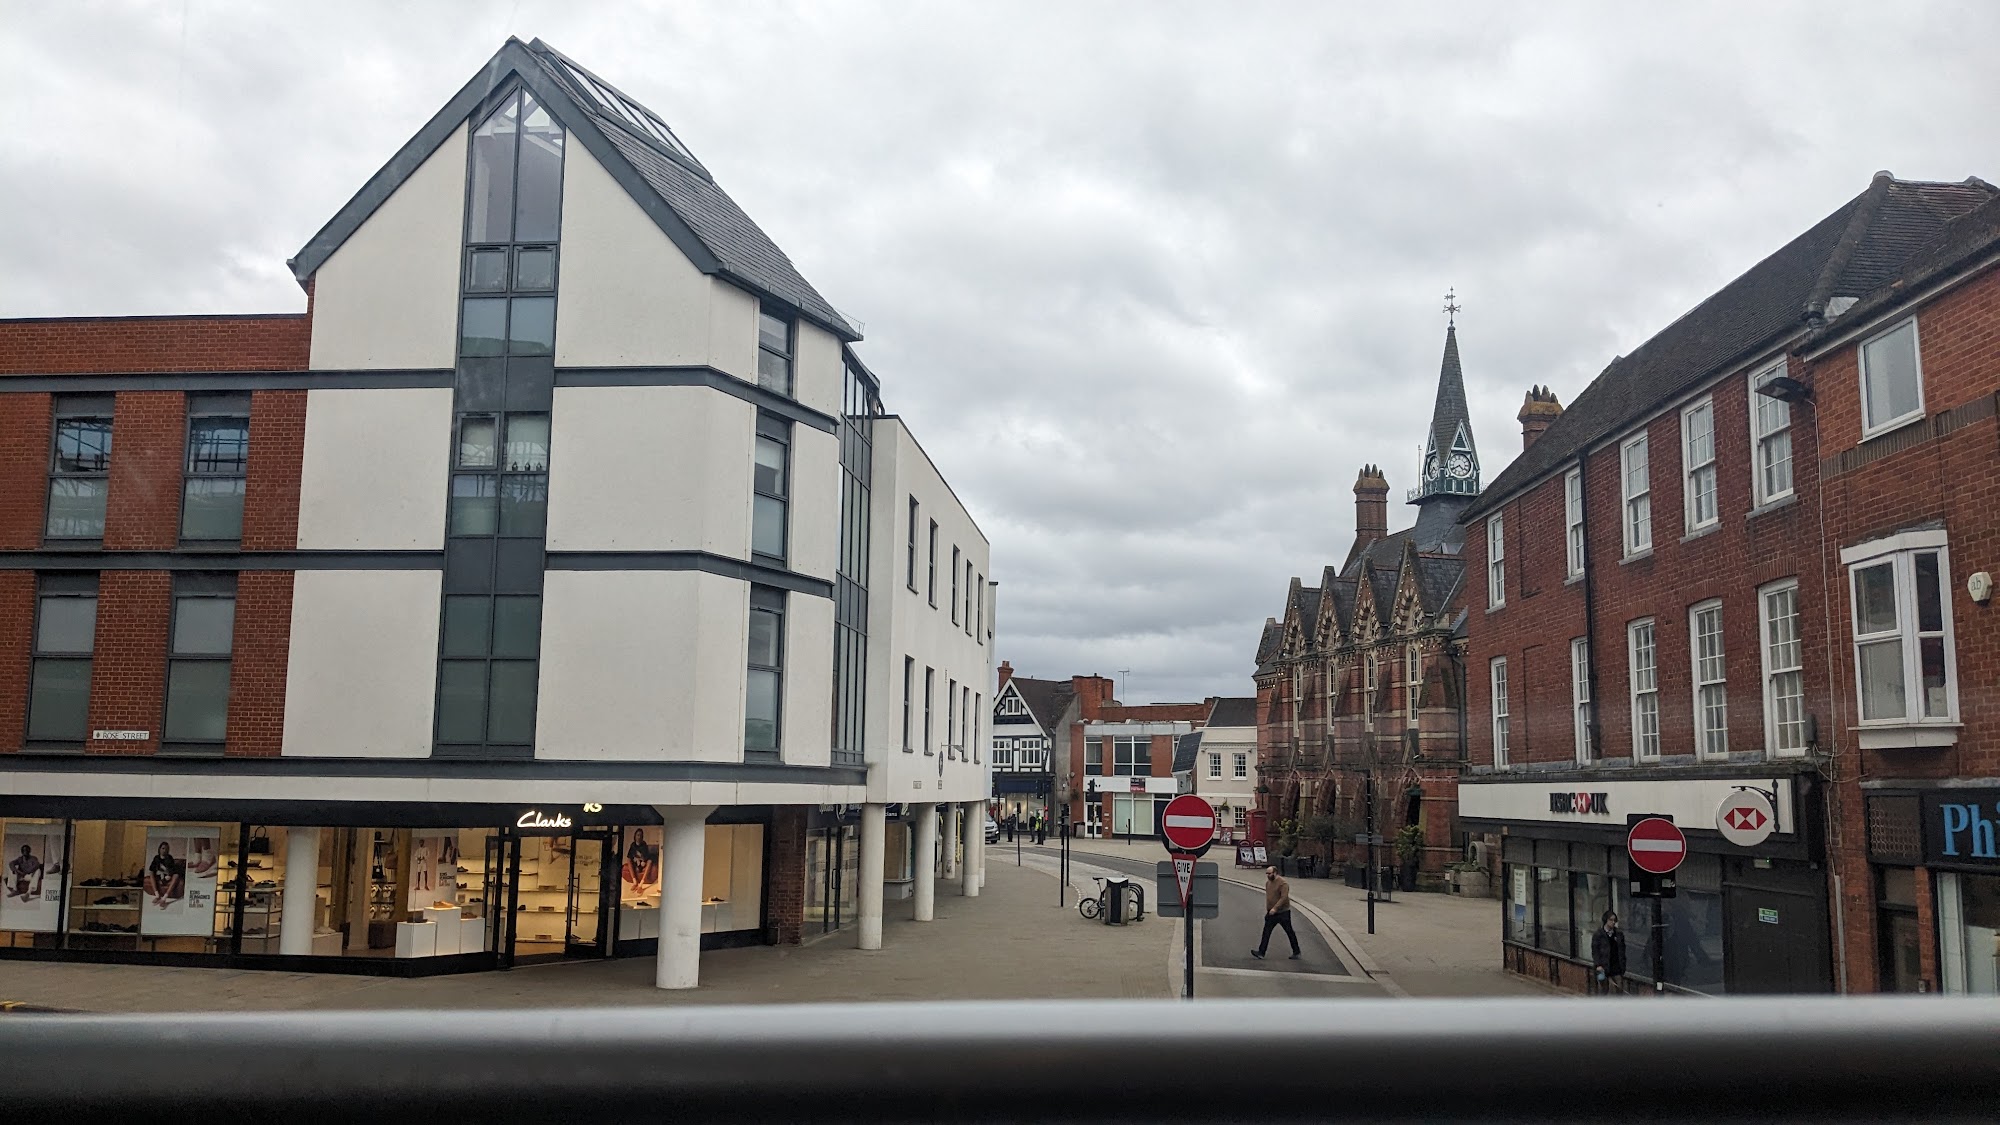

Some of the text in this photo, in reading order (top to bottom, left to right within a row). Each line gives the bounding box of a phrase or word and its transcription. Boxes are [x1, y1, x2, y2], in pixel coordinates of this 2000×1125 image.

[1549, 792, 1610, 814] HSBC UK
[517, 810, 571, 828] Clarks
[1177, 861, 1191, 874] GIVE
